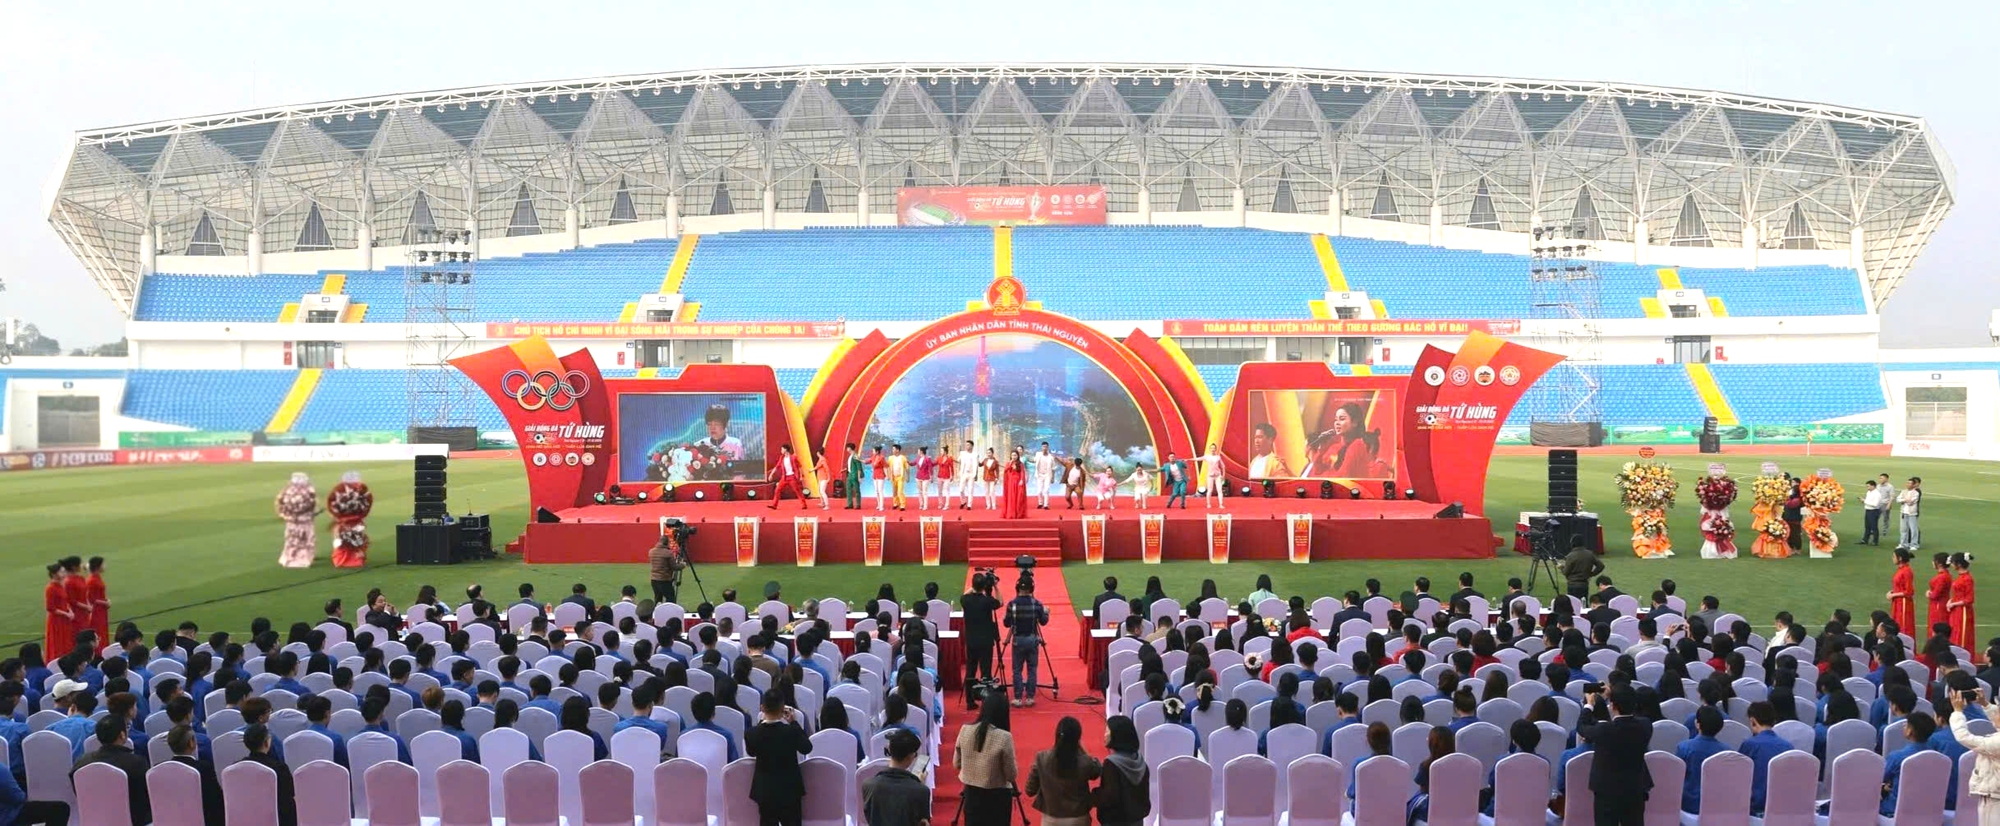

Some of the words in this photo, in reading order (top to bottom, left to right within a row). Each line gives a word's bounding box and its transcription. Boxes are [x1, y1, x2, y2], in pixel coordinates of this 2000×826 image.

[673, 326, 698, 334] TRONG
[939, 330, 958, 342] BAN
[959, 323, 985, 335] NHÂN
[986, 321, 1006, 329] DÂN
[1032, 322, 1051, 333] THÁI
[1053, 328, 1088, 349] NGUYÊN
[1203, 323, 1227, 332] TOÀN
[1346, 323, 1368, 332] THEO
[1466, 403, 1497, 419] HÙNG
[574, 422, 605, 438] HÙNG
